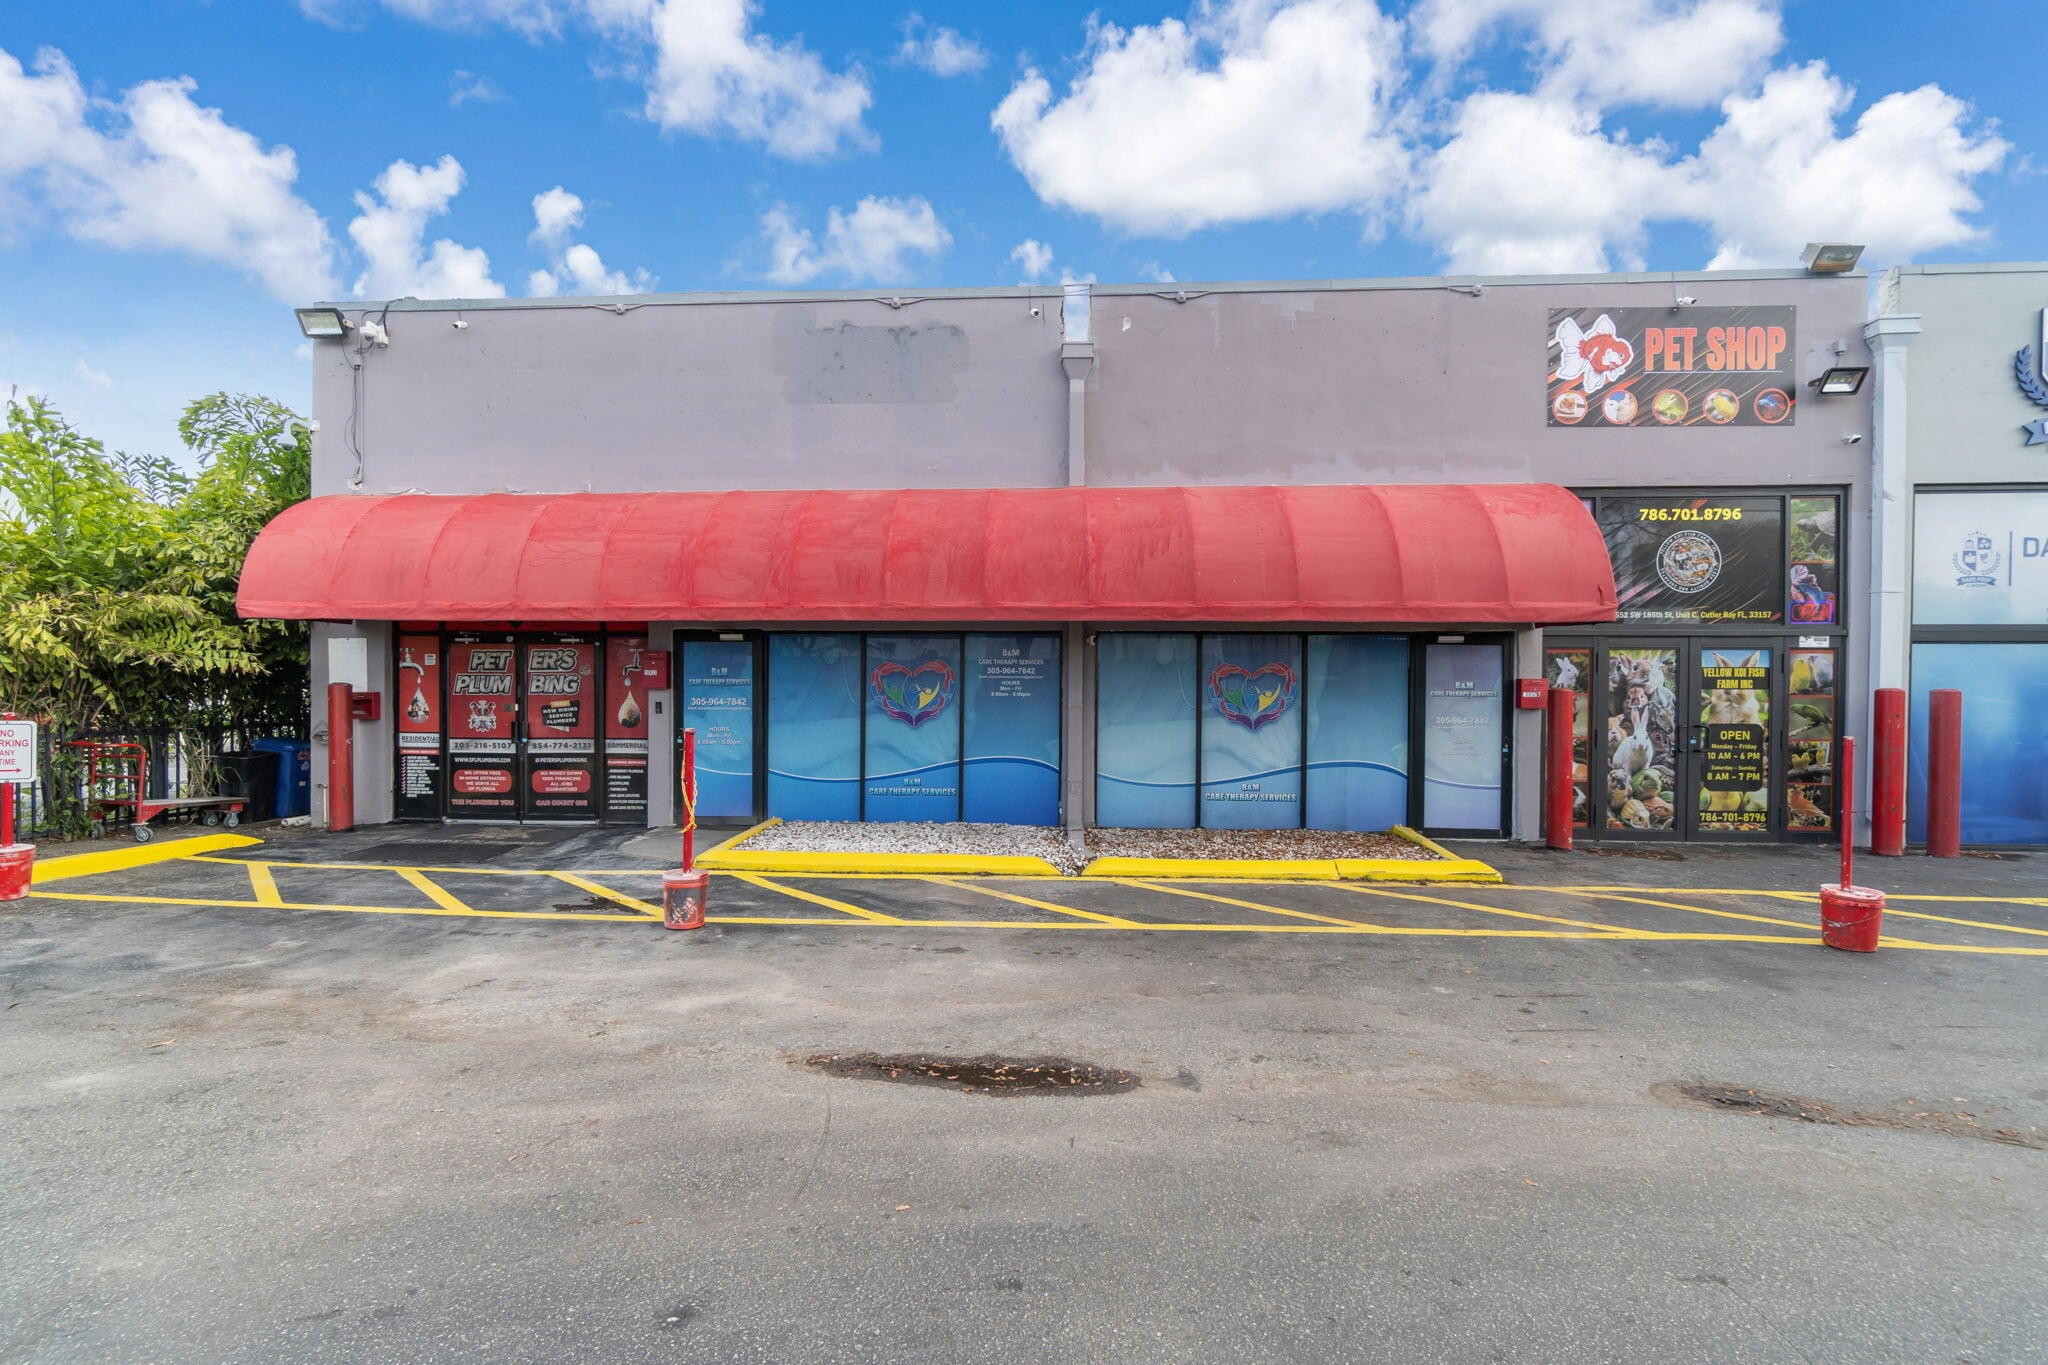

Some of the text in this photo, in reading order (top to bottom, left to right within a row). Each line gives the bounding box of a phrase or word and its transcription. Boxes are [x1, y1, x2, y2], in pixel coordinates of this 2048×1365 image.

[1645, 326, 1786, 371] PET SHOP
[1640, 508, 1742, 520] 786.701.8796
[1723, 611, 1736, 620] Bay
[1737, 611, 1747, 619] FL,
[1792, 604, 1830, 621] OPEN
[470, 650, 514, 672] PET
[1703, 668, 1765, 677] YELLOW KOI FISH
[454, 674, 580, 695] PLUM BING
[1717, 680, 1753, 688] FARM INC
[1720, 730, 1750, 740] OPEN
[921, 788, 956, 796] SERVICES
[1226, 793, 1259, 801] THERAPY
[1260, 793, 1297, 802] SERVICES
[1700, 812, 1766, 822] 786-701-8796
